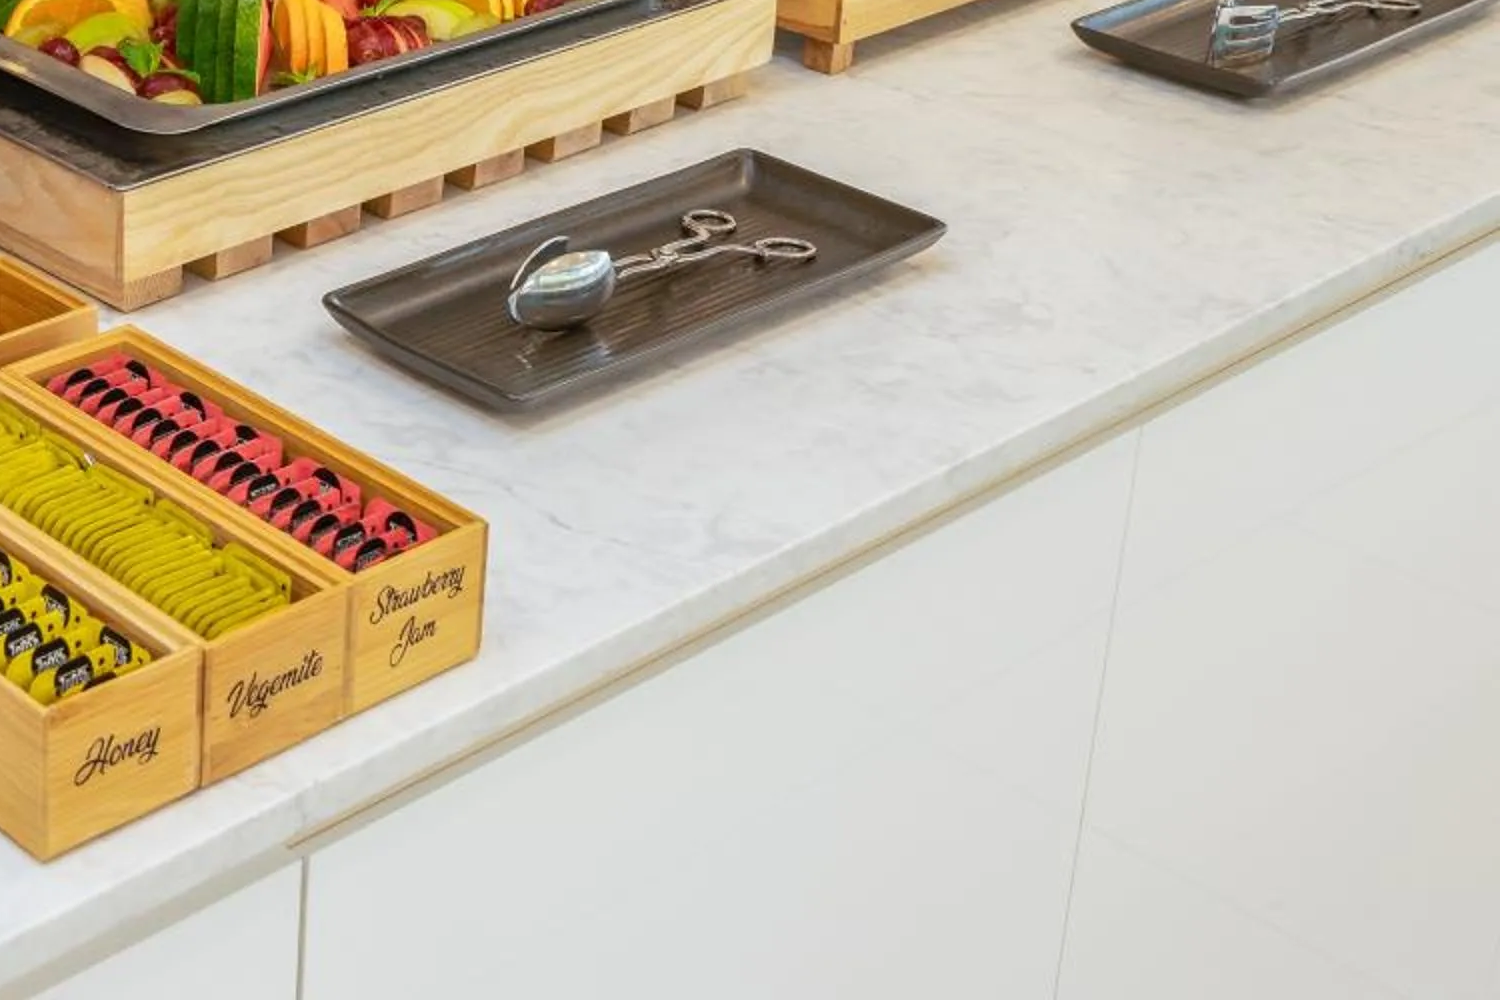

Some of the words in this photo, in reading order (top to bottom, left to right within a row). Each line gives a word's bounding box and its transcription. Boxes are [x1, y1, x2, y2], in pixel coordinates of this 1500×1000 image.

[369, 564, 467, 625] Strawberry
[389, 614, 438, 668] Jam
[226, 648, 325, 719] Vegemite
[74, 725, 161, 787] Honey
